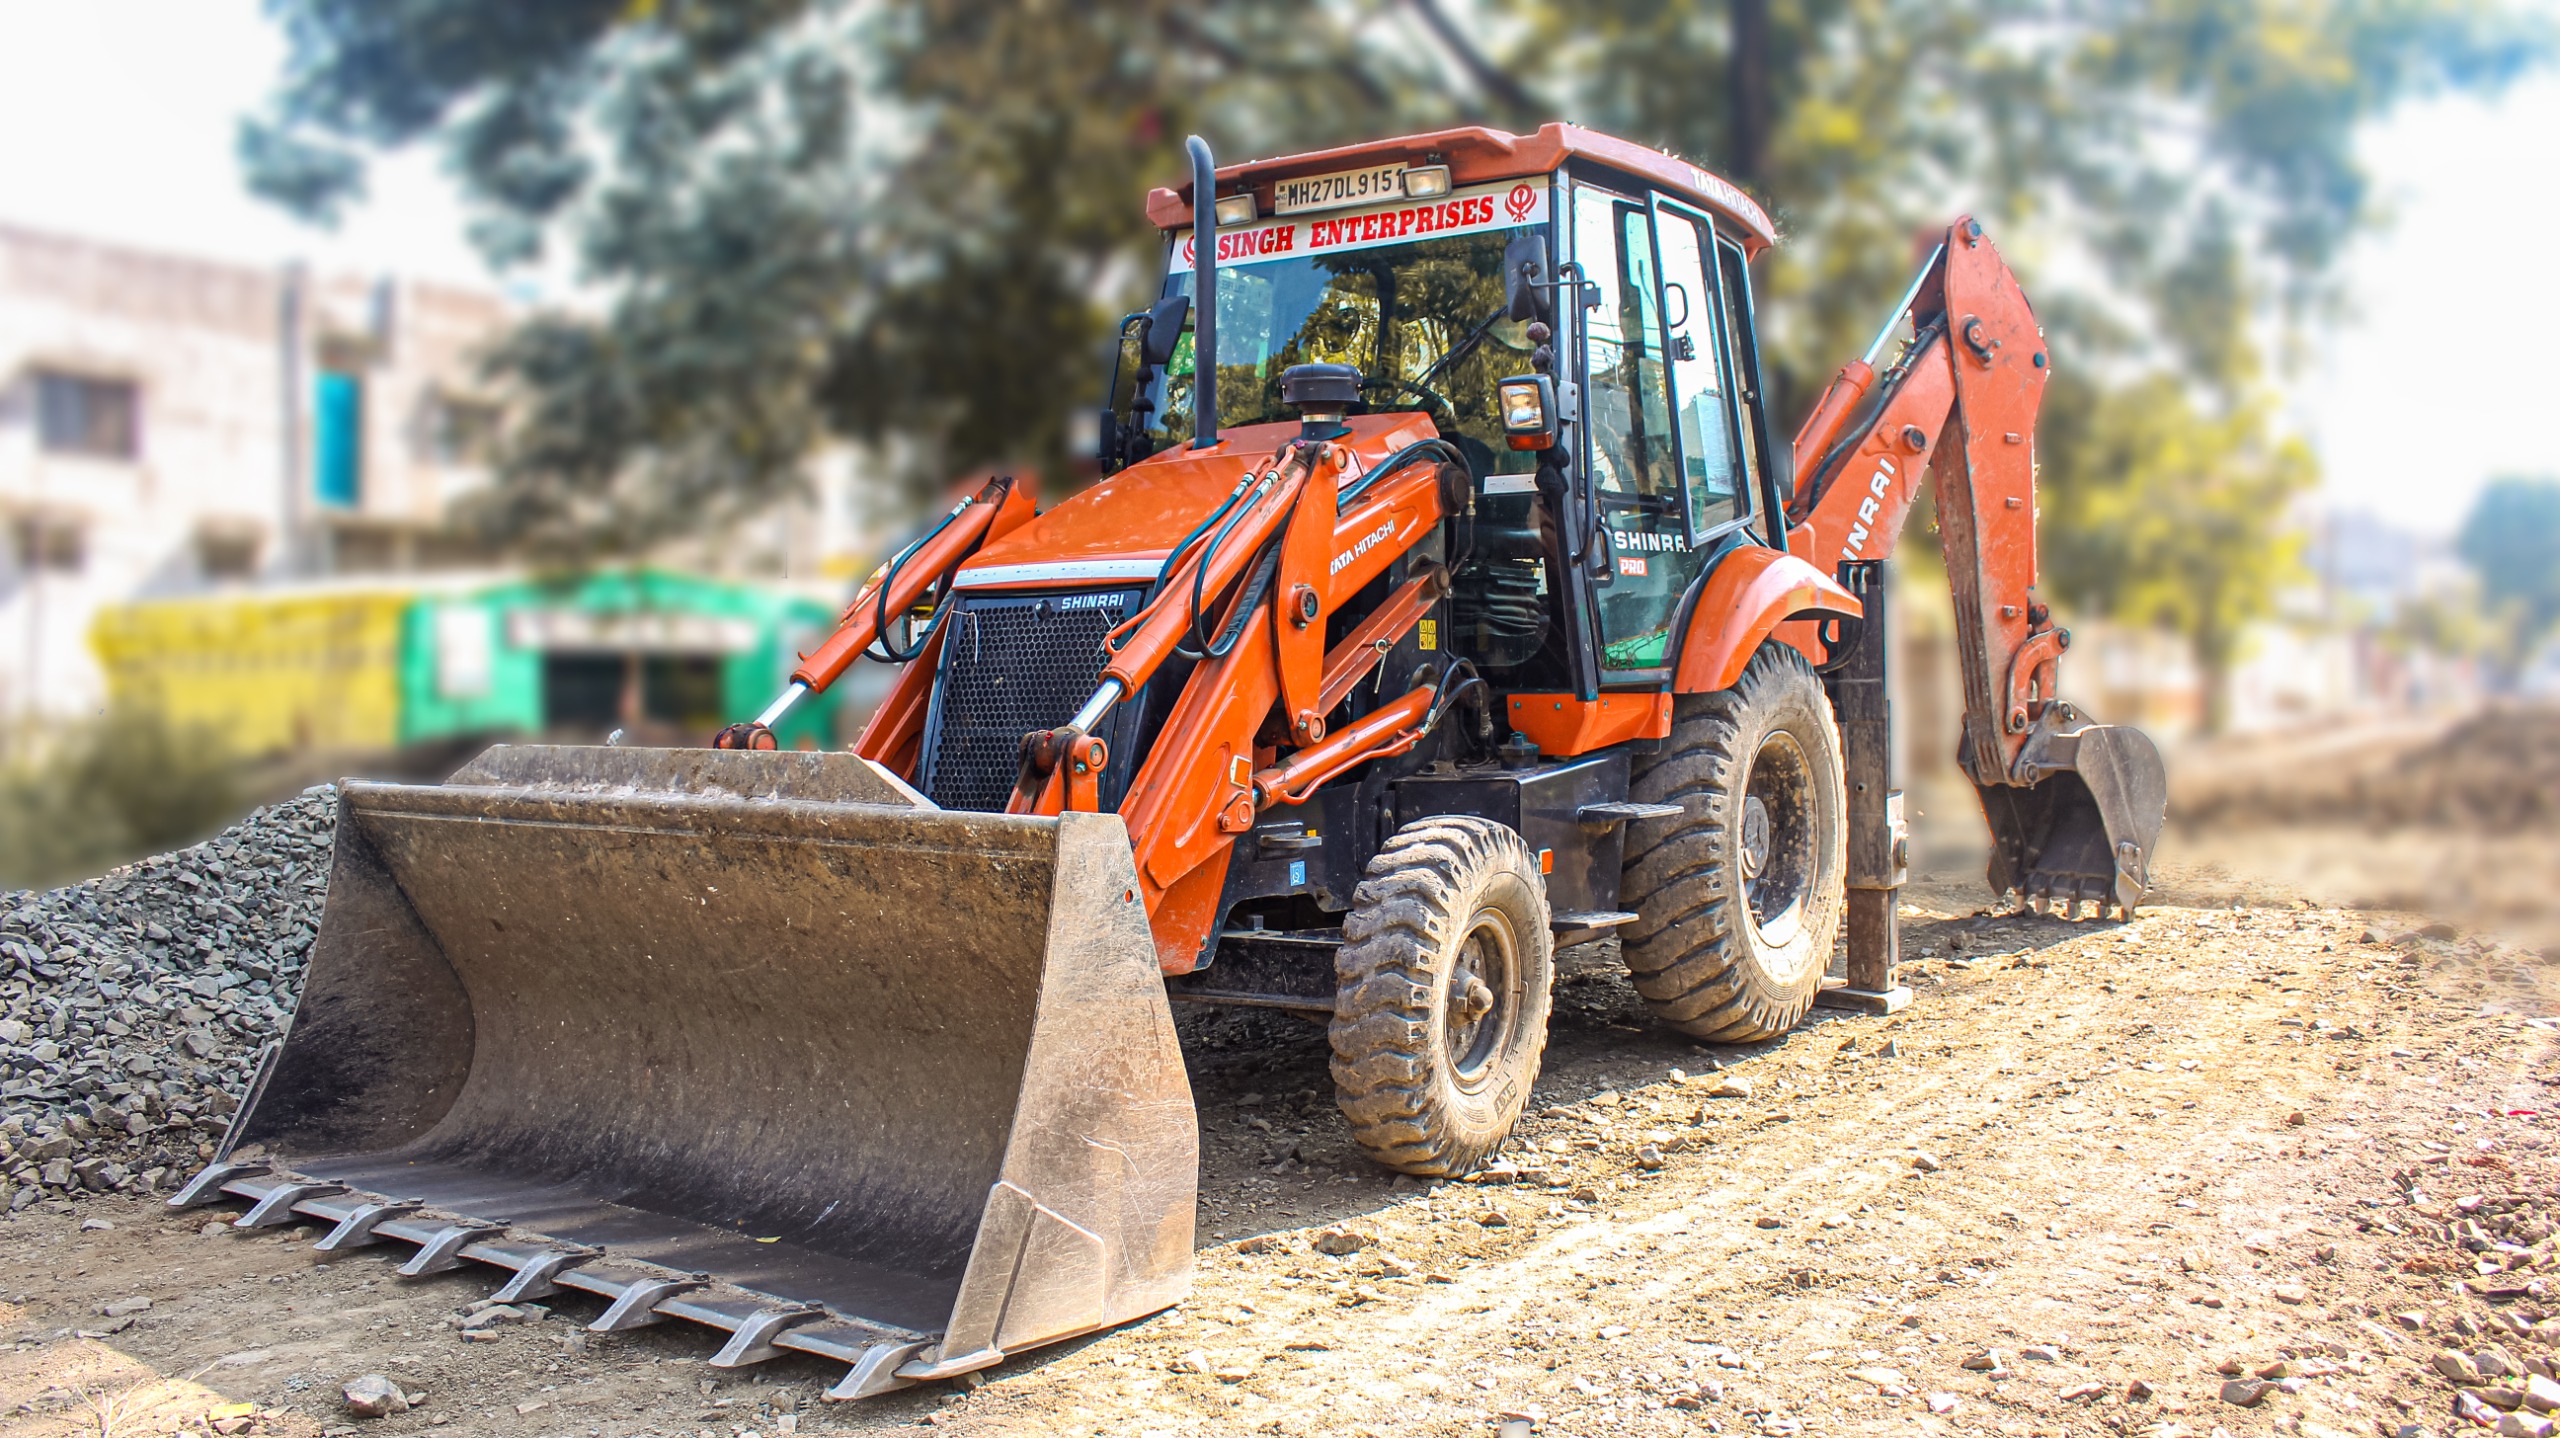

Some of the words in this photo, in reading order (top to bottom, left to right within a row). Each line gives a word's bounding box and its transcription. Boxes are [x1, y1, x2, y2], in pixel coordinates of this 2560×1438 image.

[1288, 168, 1404, 206] MH27DL9151
[1690, 167, 1724, 200] TATA
[1217, 225, 1296, 260] SINGH
[1309, 195, 1494, 248] ENTERPRISES
[1831, 458, 1896, 582] INRAI
[1329, 549, 1355, 576] TATA
[1354, 519, 1395, 557] HITACHI
[1614, 530, 1693, 553] SHINRA
[1620, 559, 1645, 575] PRO
[1061, 593, 1125, 610] SHINRAI
